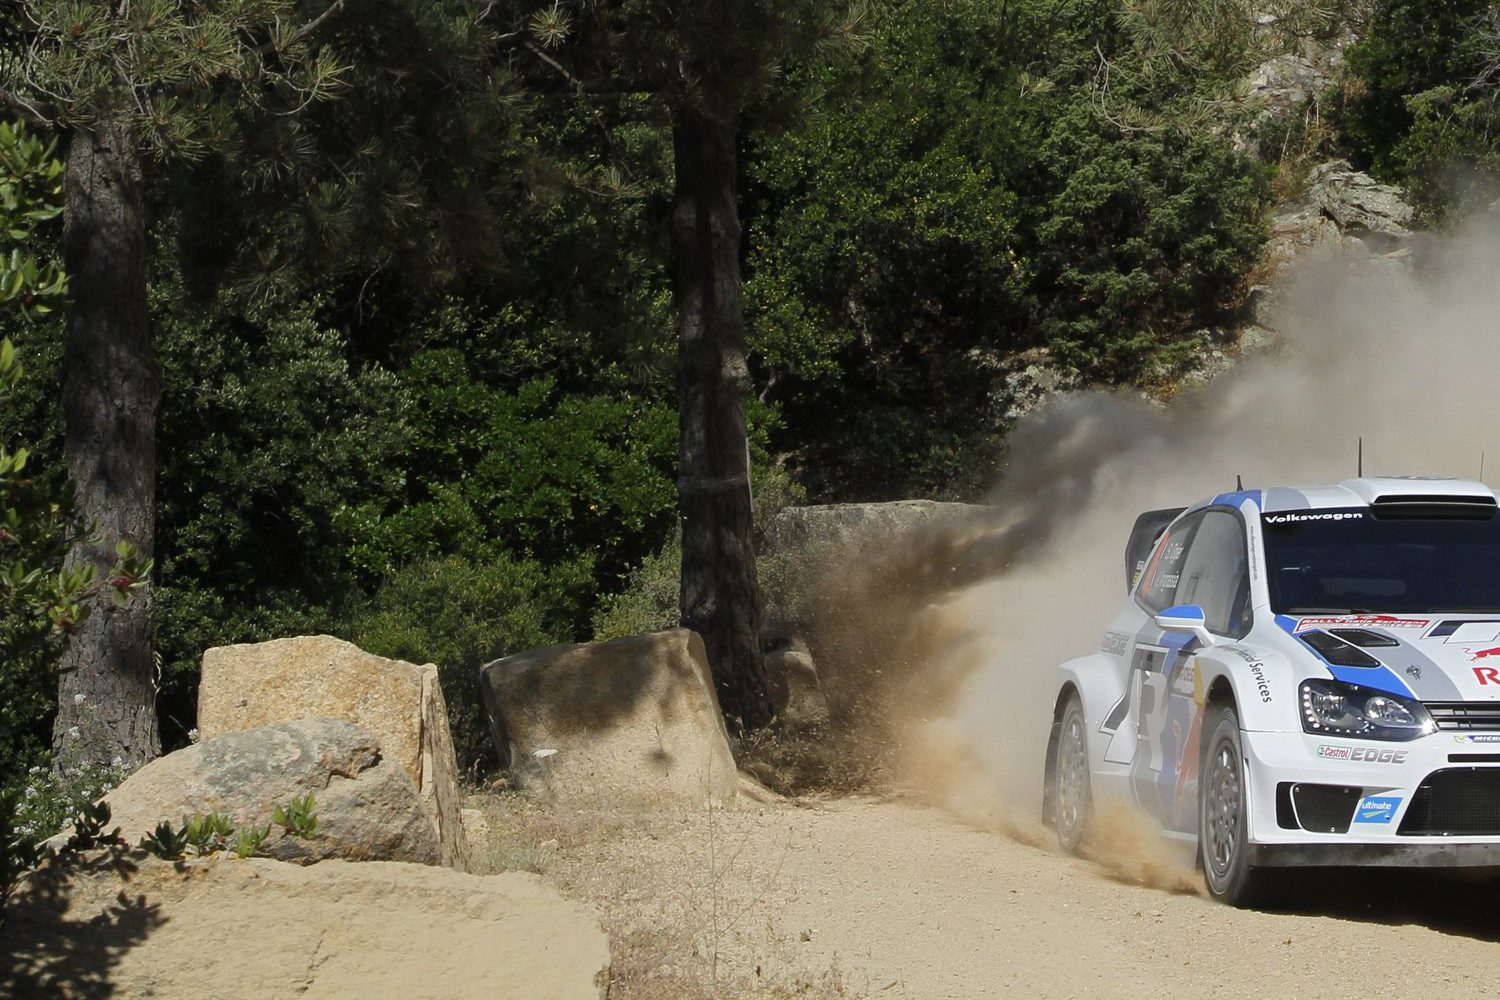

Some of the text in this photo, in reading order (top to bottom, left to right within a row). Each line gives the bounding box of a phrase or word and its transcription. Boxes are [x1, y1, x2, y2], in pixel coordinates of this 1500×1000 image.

[1265, 513, 1363, 524] Volkswagen
[1249, 662, 1272, 703] Services
[1324, 746, 1409, 764] Castrol EDGE
[1361, 801, 1392, 810] ultimate
